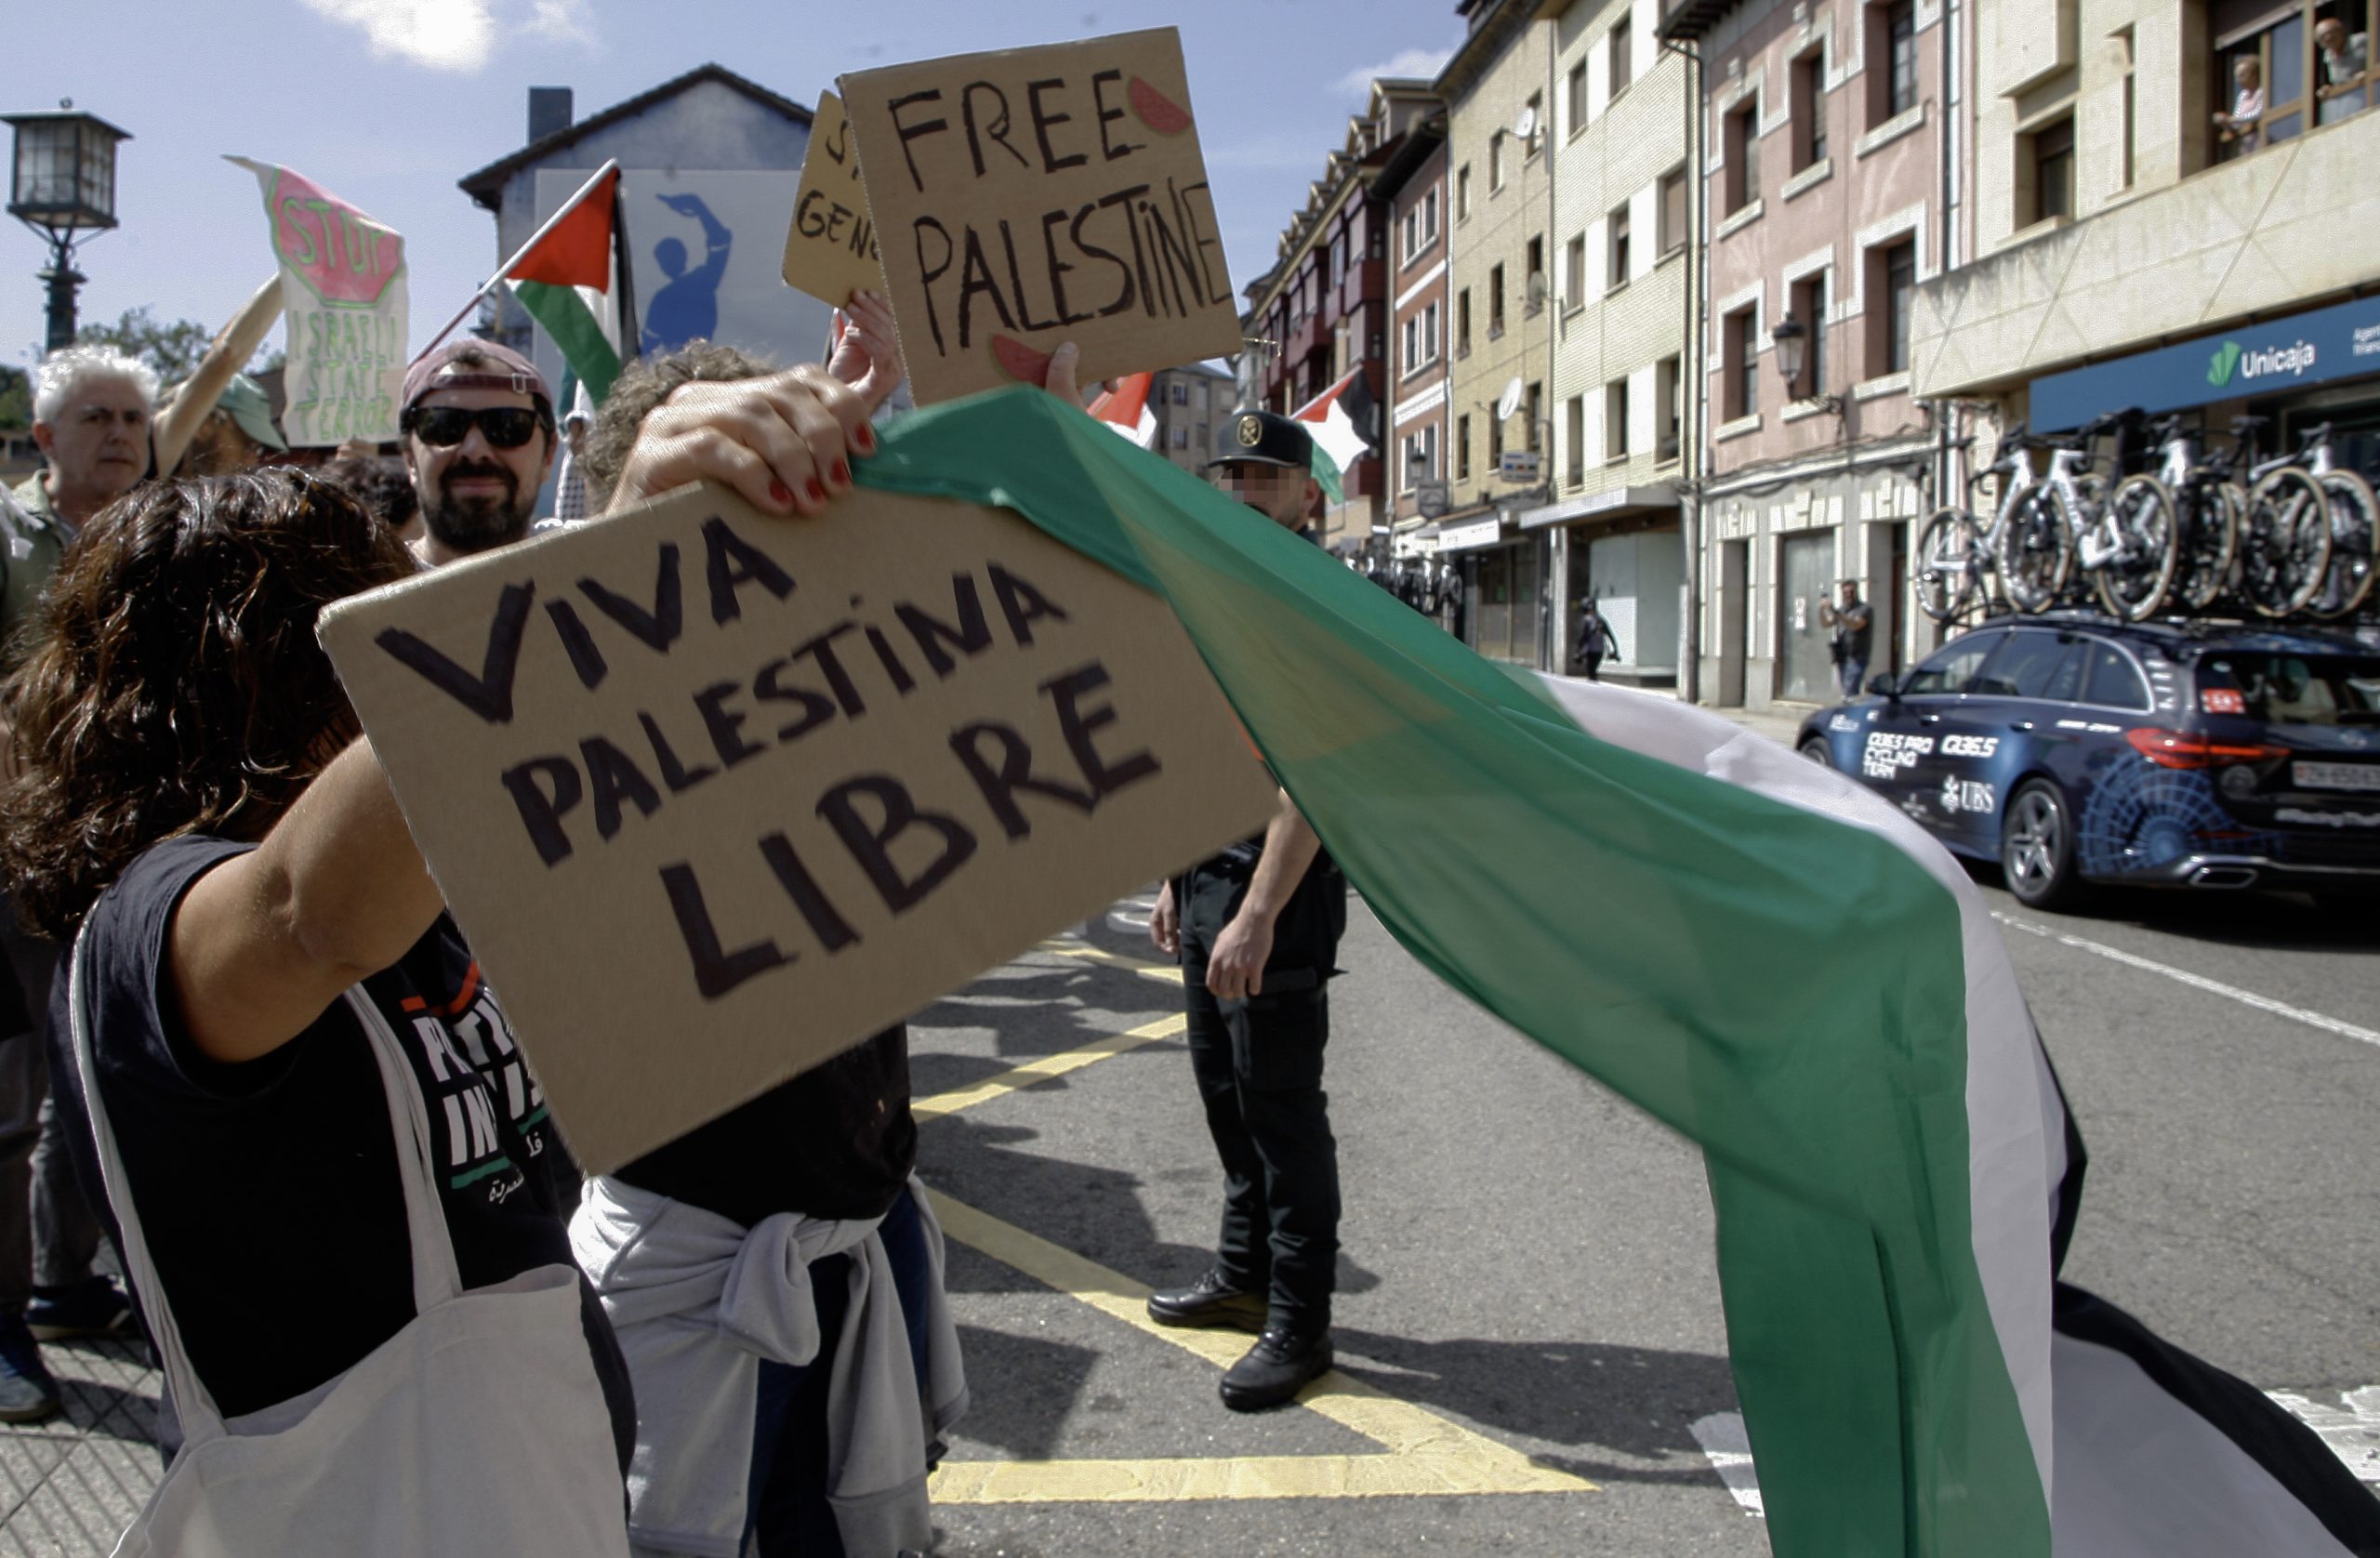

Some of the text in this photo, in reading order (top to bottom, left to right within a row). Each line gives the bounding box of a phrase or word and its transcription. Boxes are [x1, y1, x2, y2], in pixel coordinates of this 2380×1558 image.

[888, 69, 1145, 192] FREE
[282, 196, 387, 276] STOP
[2241, 339, 2316, 379] Unicaja
[375, 515, 797, 724] VIVA
[659, 661, 1163, 1002] LIBRE
